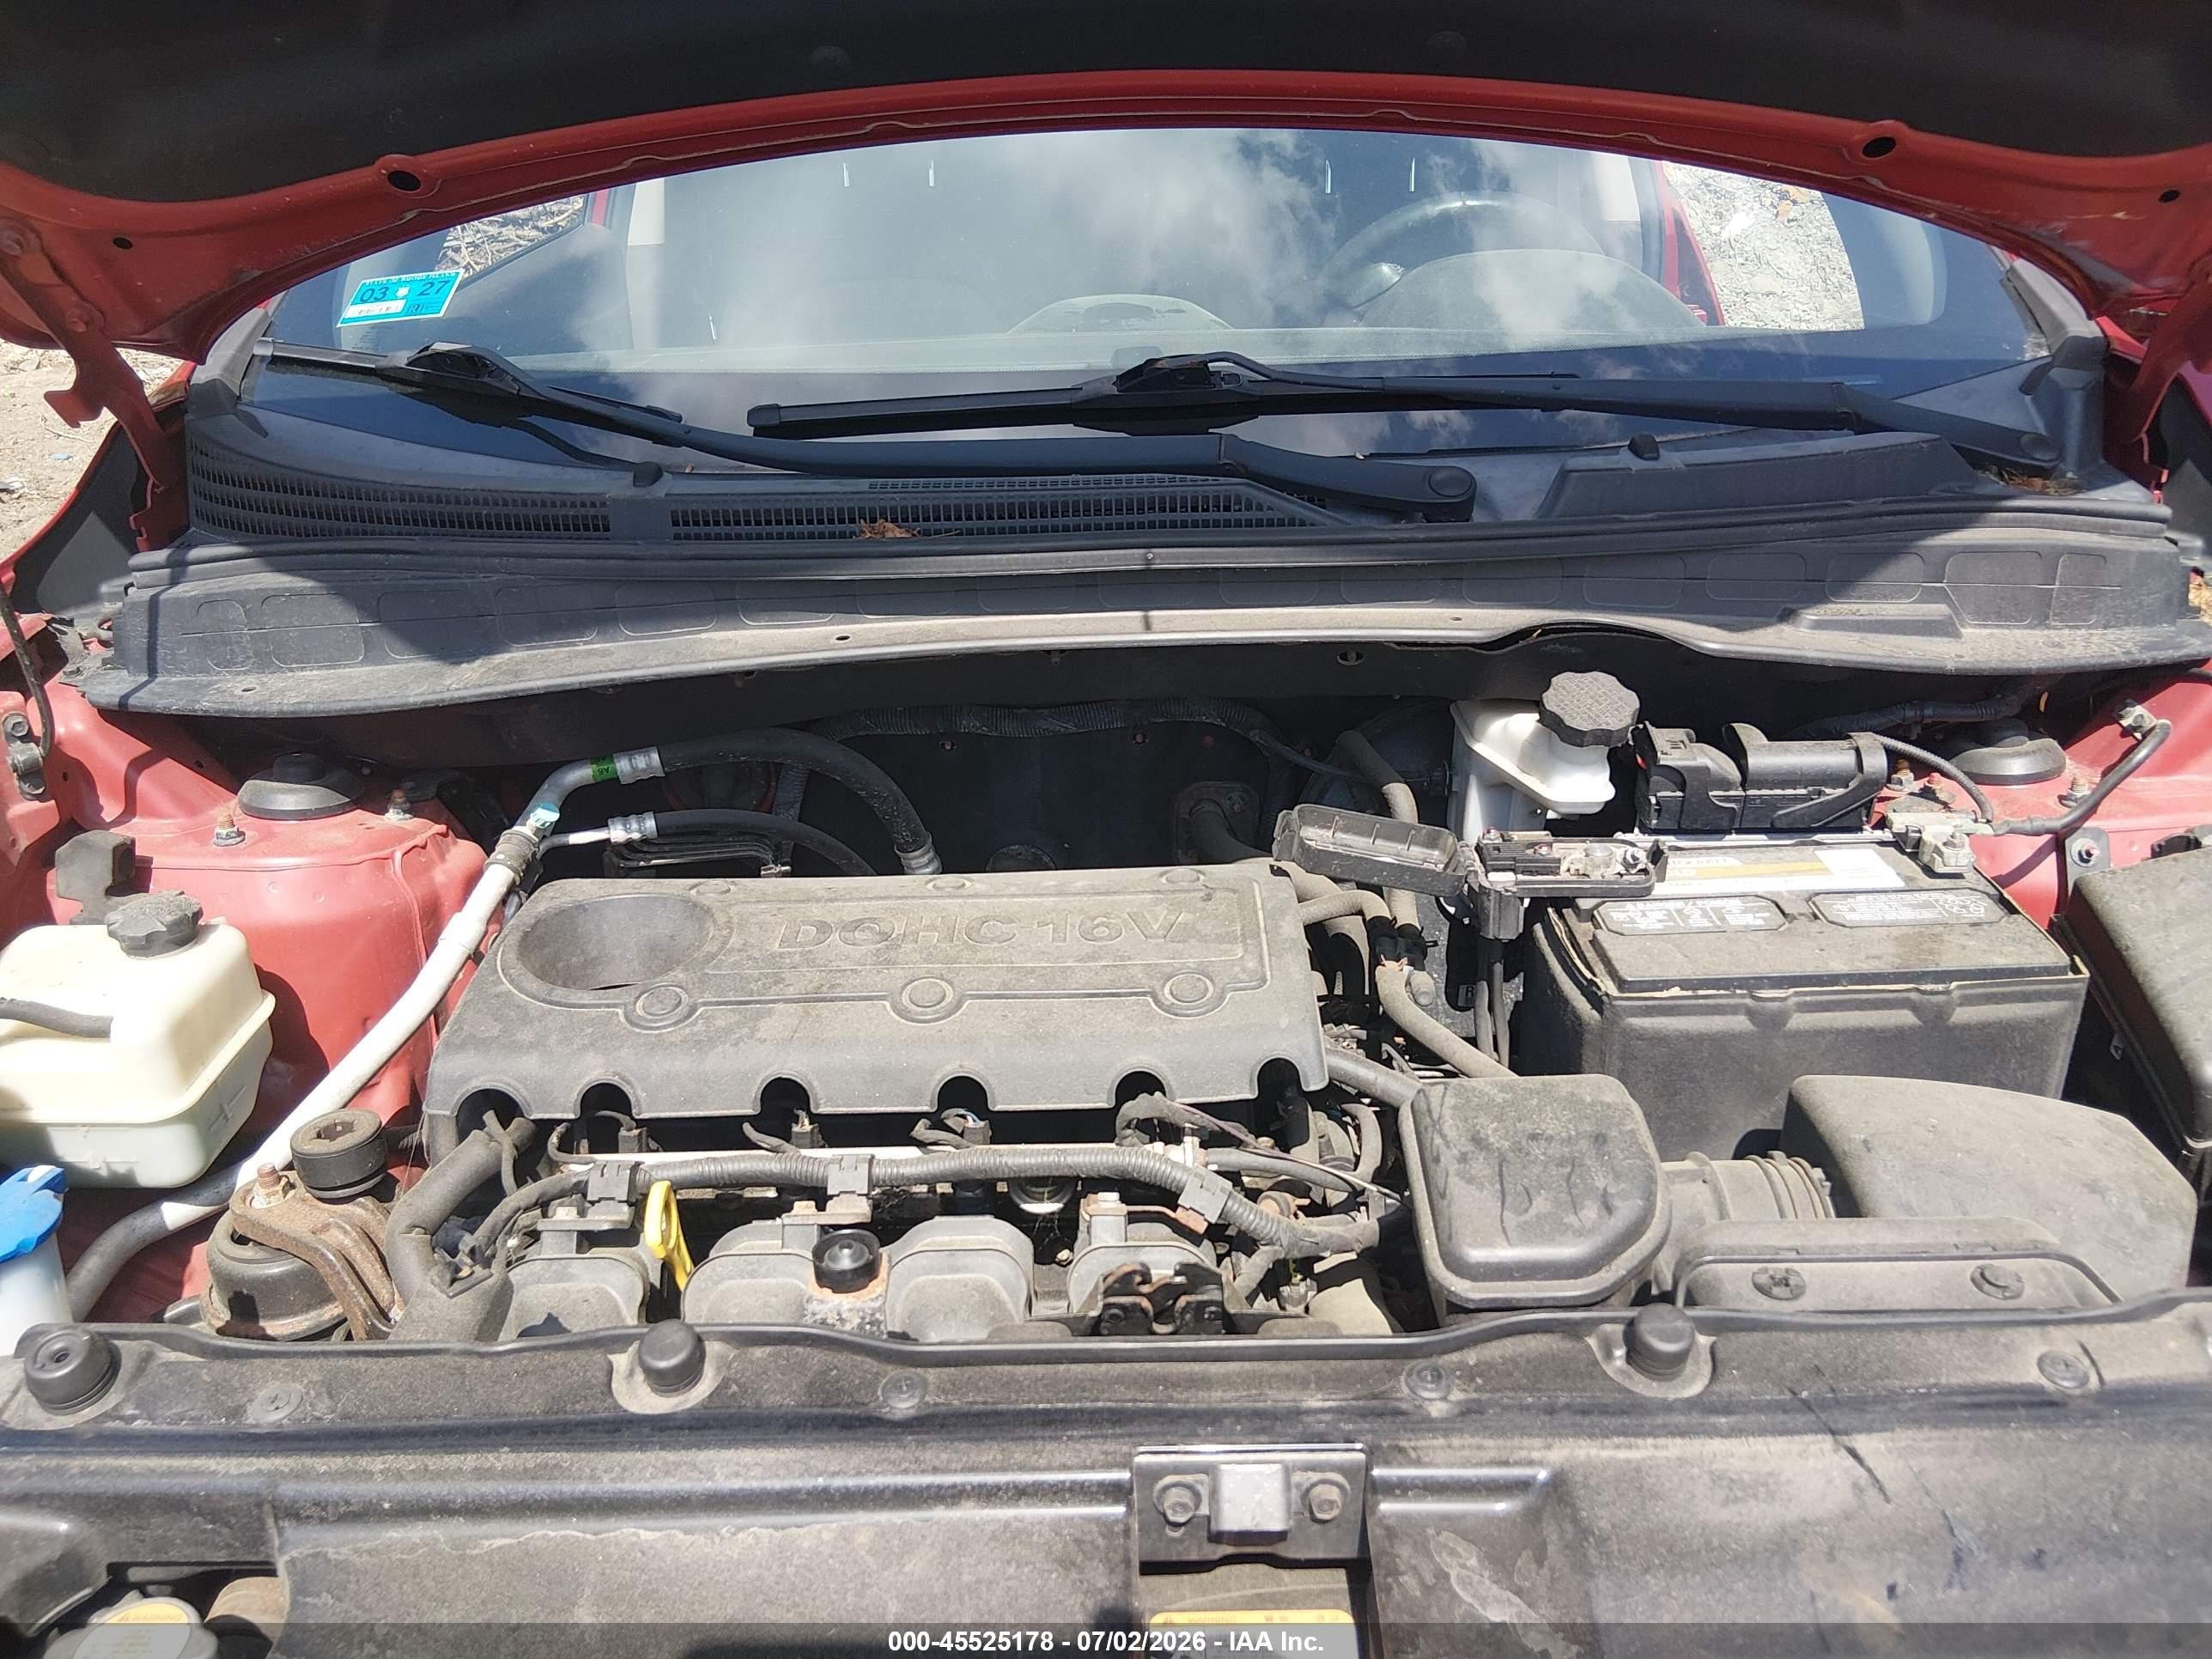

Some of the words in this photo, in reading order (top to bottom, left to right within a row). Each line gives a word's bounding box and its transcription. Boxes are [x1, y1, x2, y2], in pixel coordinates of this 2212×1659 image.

[360, 286, 390, 303] 03
[417, 280, 450, 297] 27
[779, 915, 1018, 949] DOHC
[1036, 910, 1183, 945] 16V
